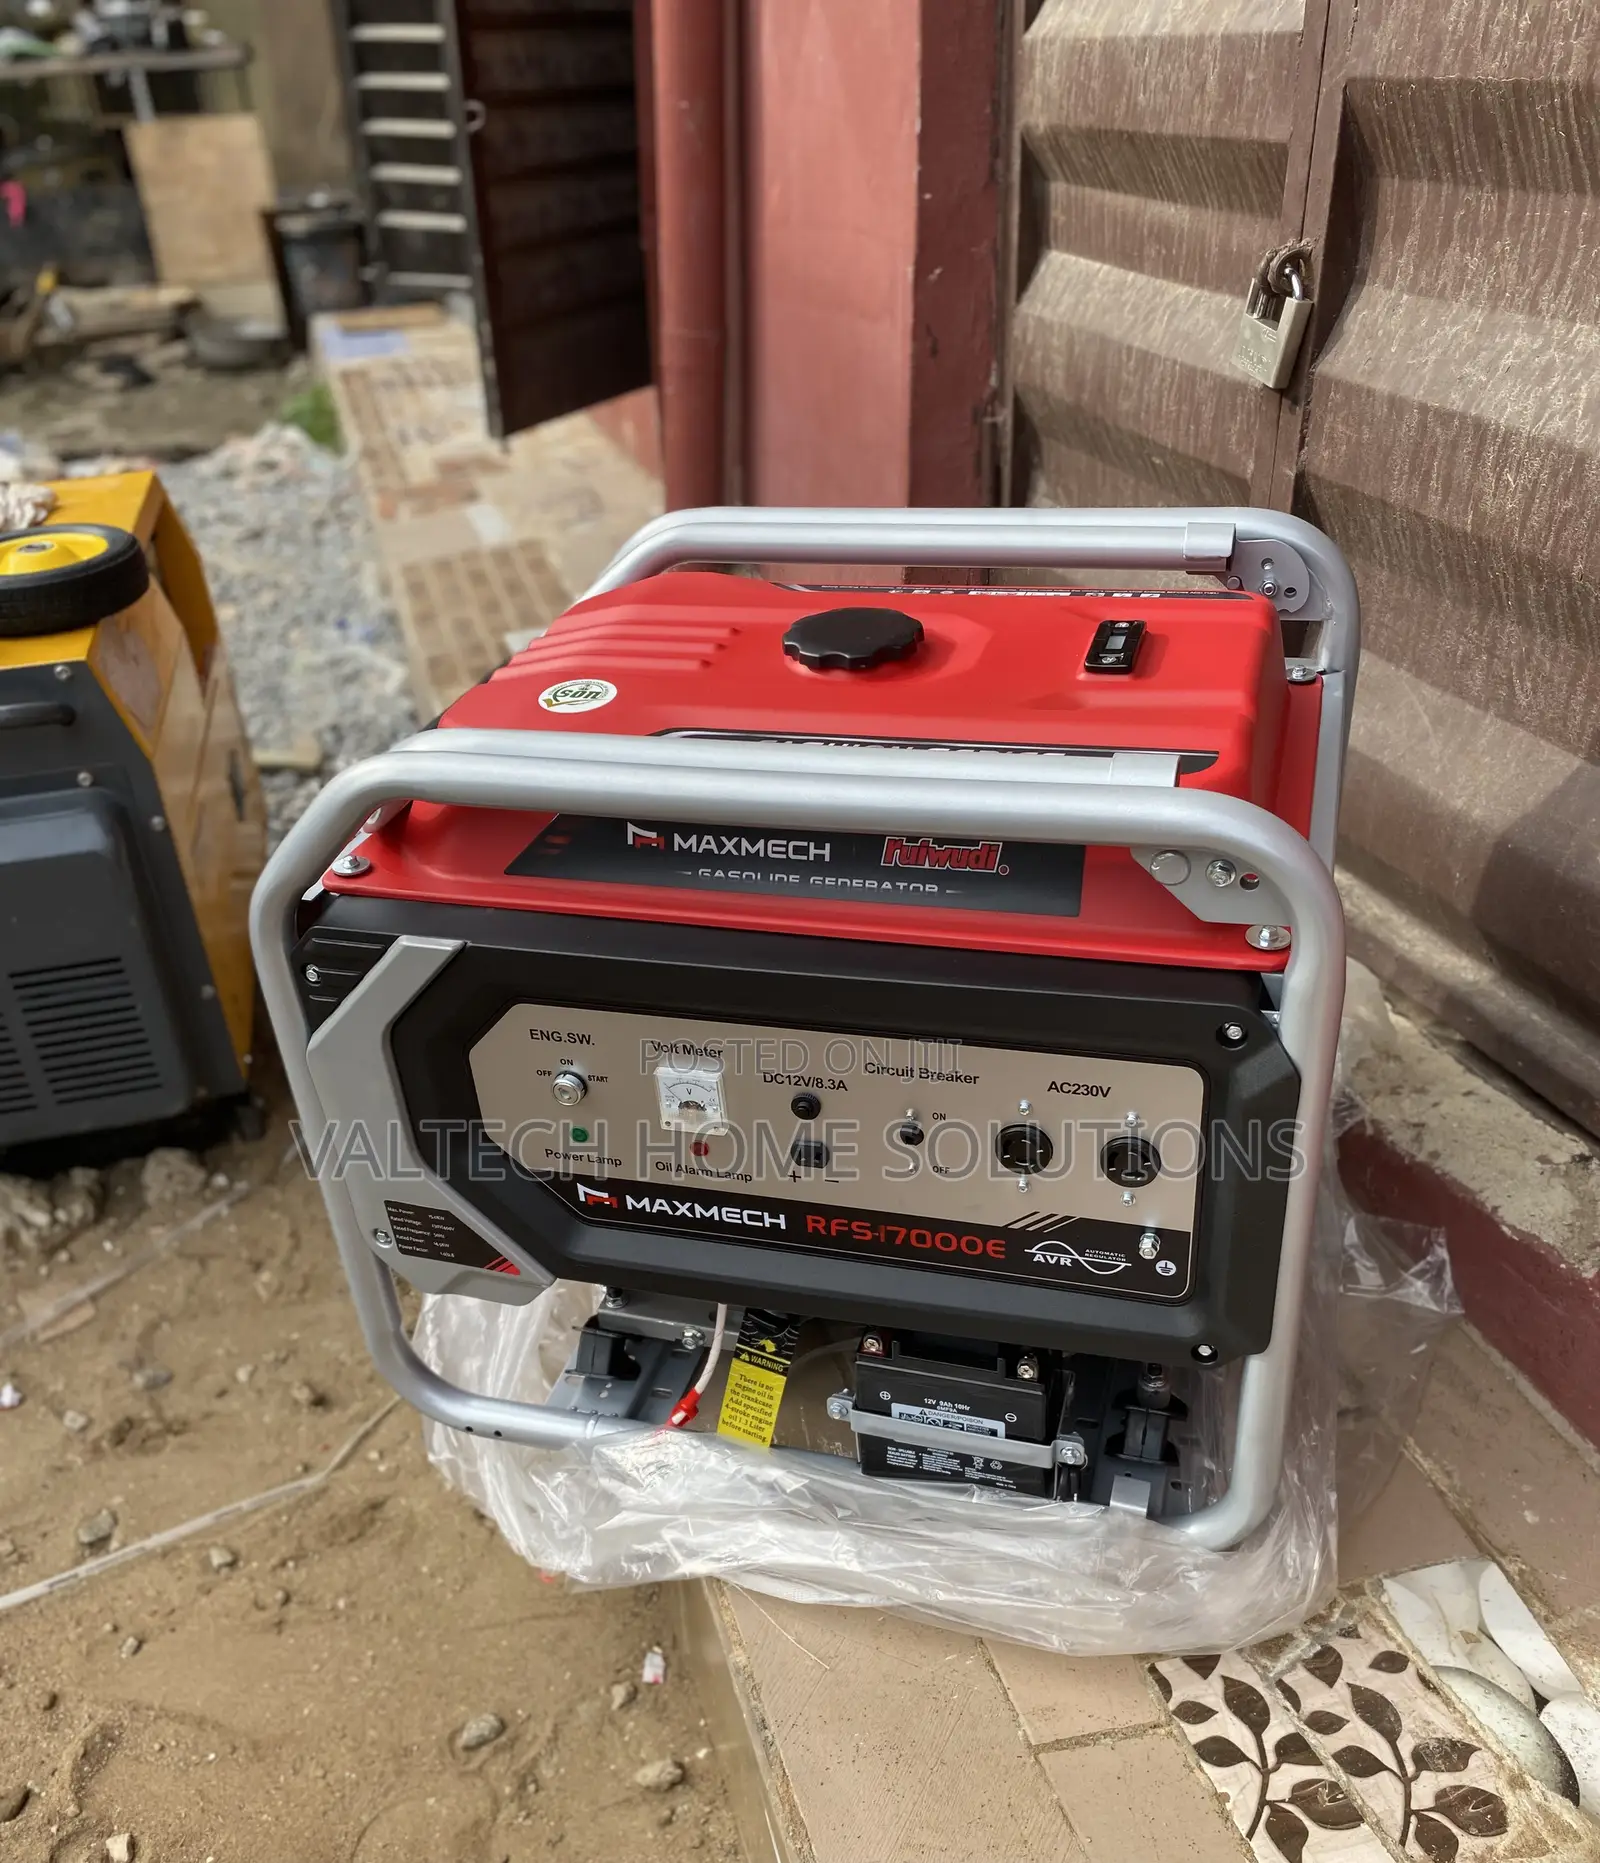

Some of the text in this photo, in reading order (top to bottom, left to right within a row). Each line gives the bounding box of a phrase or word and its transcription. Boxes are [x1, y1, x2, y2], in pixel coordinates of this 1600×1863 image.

[673, 832, 830, 863] MAXMECH
[529, 1028, 596, 1046] ENG.SW.
[650, 1040, 724, 1059] Volt Meter
[559, 1058, 574, 1066] ON
[536, 1069, 553, 1077] OFF
[587, 1074, 609, 1083] START
[864, 1062, 980, 1085] Circuit Breaker
[763, 1071, 849, 1092] DC12V/8.3A
[1047, 1080, 1112, 1099] AC230V
[931, 1111, 947, 1122] ON
[544, 1148, 622, 1167] Power Lamp
[655, 1161, 753, 1183] Oil Alarm Lamp
[931, 1164, 951, 1176] OFF
[625, 1194, 787, 1230] MAXMECH
[1032, 1253, 1073, 1267] AVR
[1084, 1253, 1127, 1262] REGULATOR
[1085, 1249, 1126, 1258] AUTOMATIC
[751, 1355, 784, 1372] WARNING
[739, 1373, 758, 1385] There
[730, 1388, 740, 1396] the
[735, 1382, 756, 1394] engine
[756, 1388, 766, 1396] oil
[728, 1396, 773, 1417] Add specified
[924, 1397, 937, 1405] 12V
[938, 1400, 953, 1408] 9Ah
[725, 1403, 773, 1427] 4-stroke engine
[927, 1410, 984, 1425] DANGER/POISON
[721, 1417, 742, 1431] before
[728, 1414, 738, 1422] oil
[749, 1421, 766, 1433] Liter
